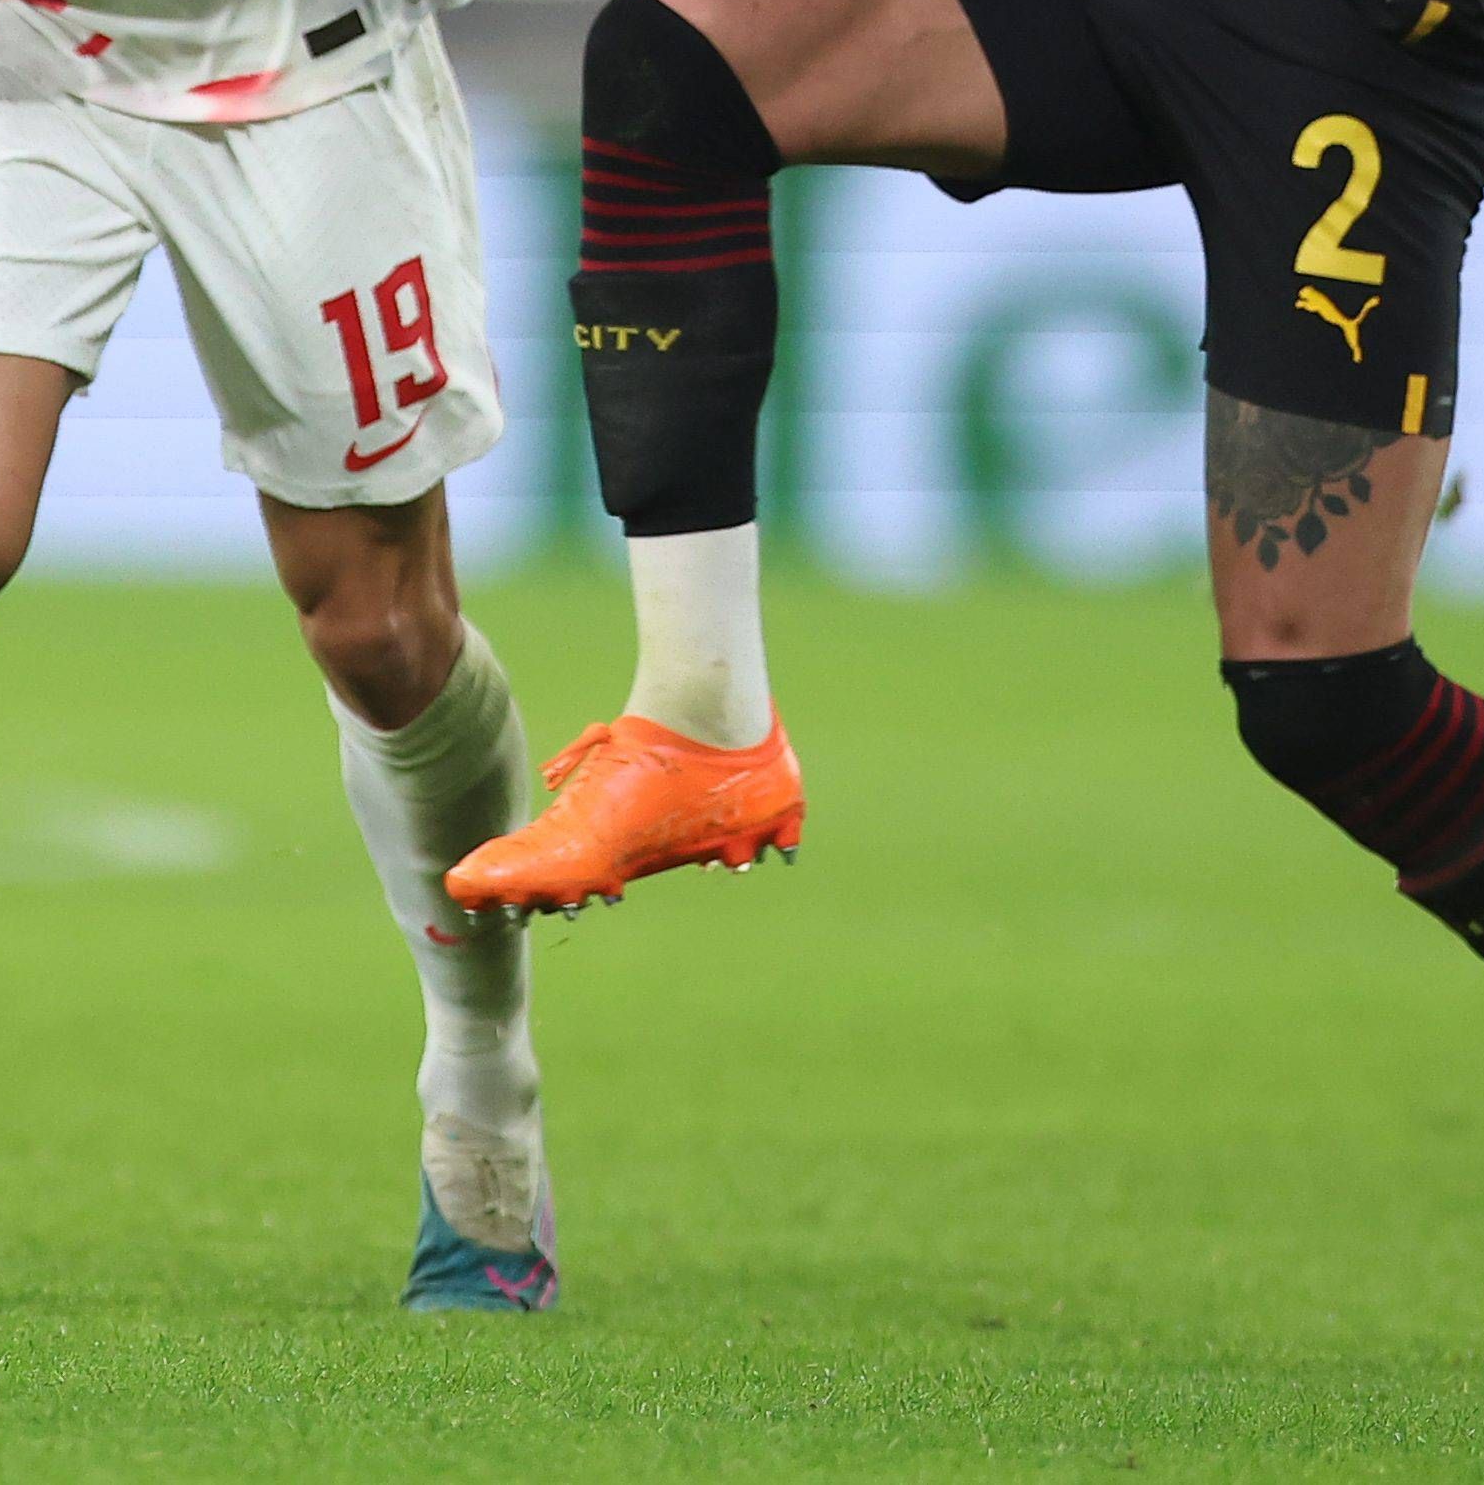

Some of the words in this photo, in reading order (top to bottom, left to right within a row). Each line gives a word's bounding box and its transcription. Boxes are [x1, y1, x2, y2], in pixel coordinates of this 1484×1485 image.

[1291, 113, 1387, 285] 2
[319, 253, 448, 429] 19
[573, 323, 682, 351] CITY
